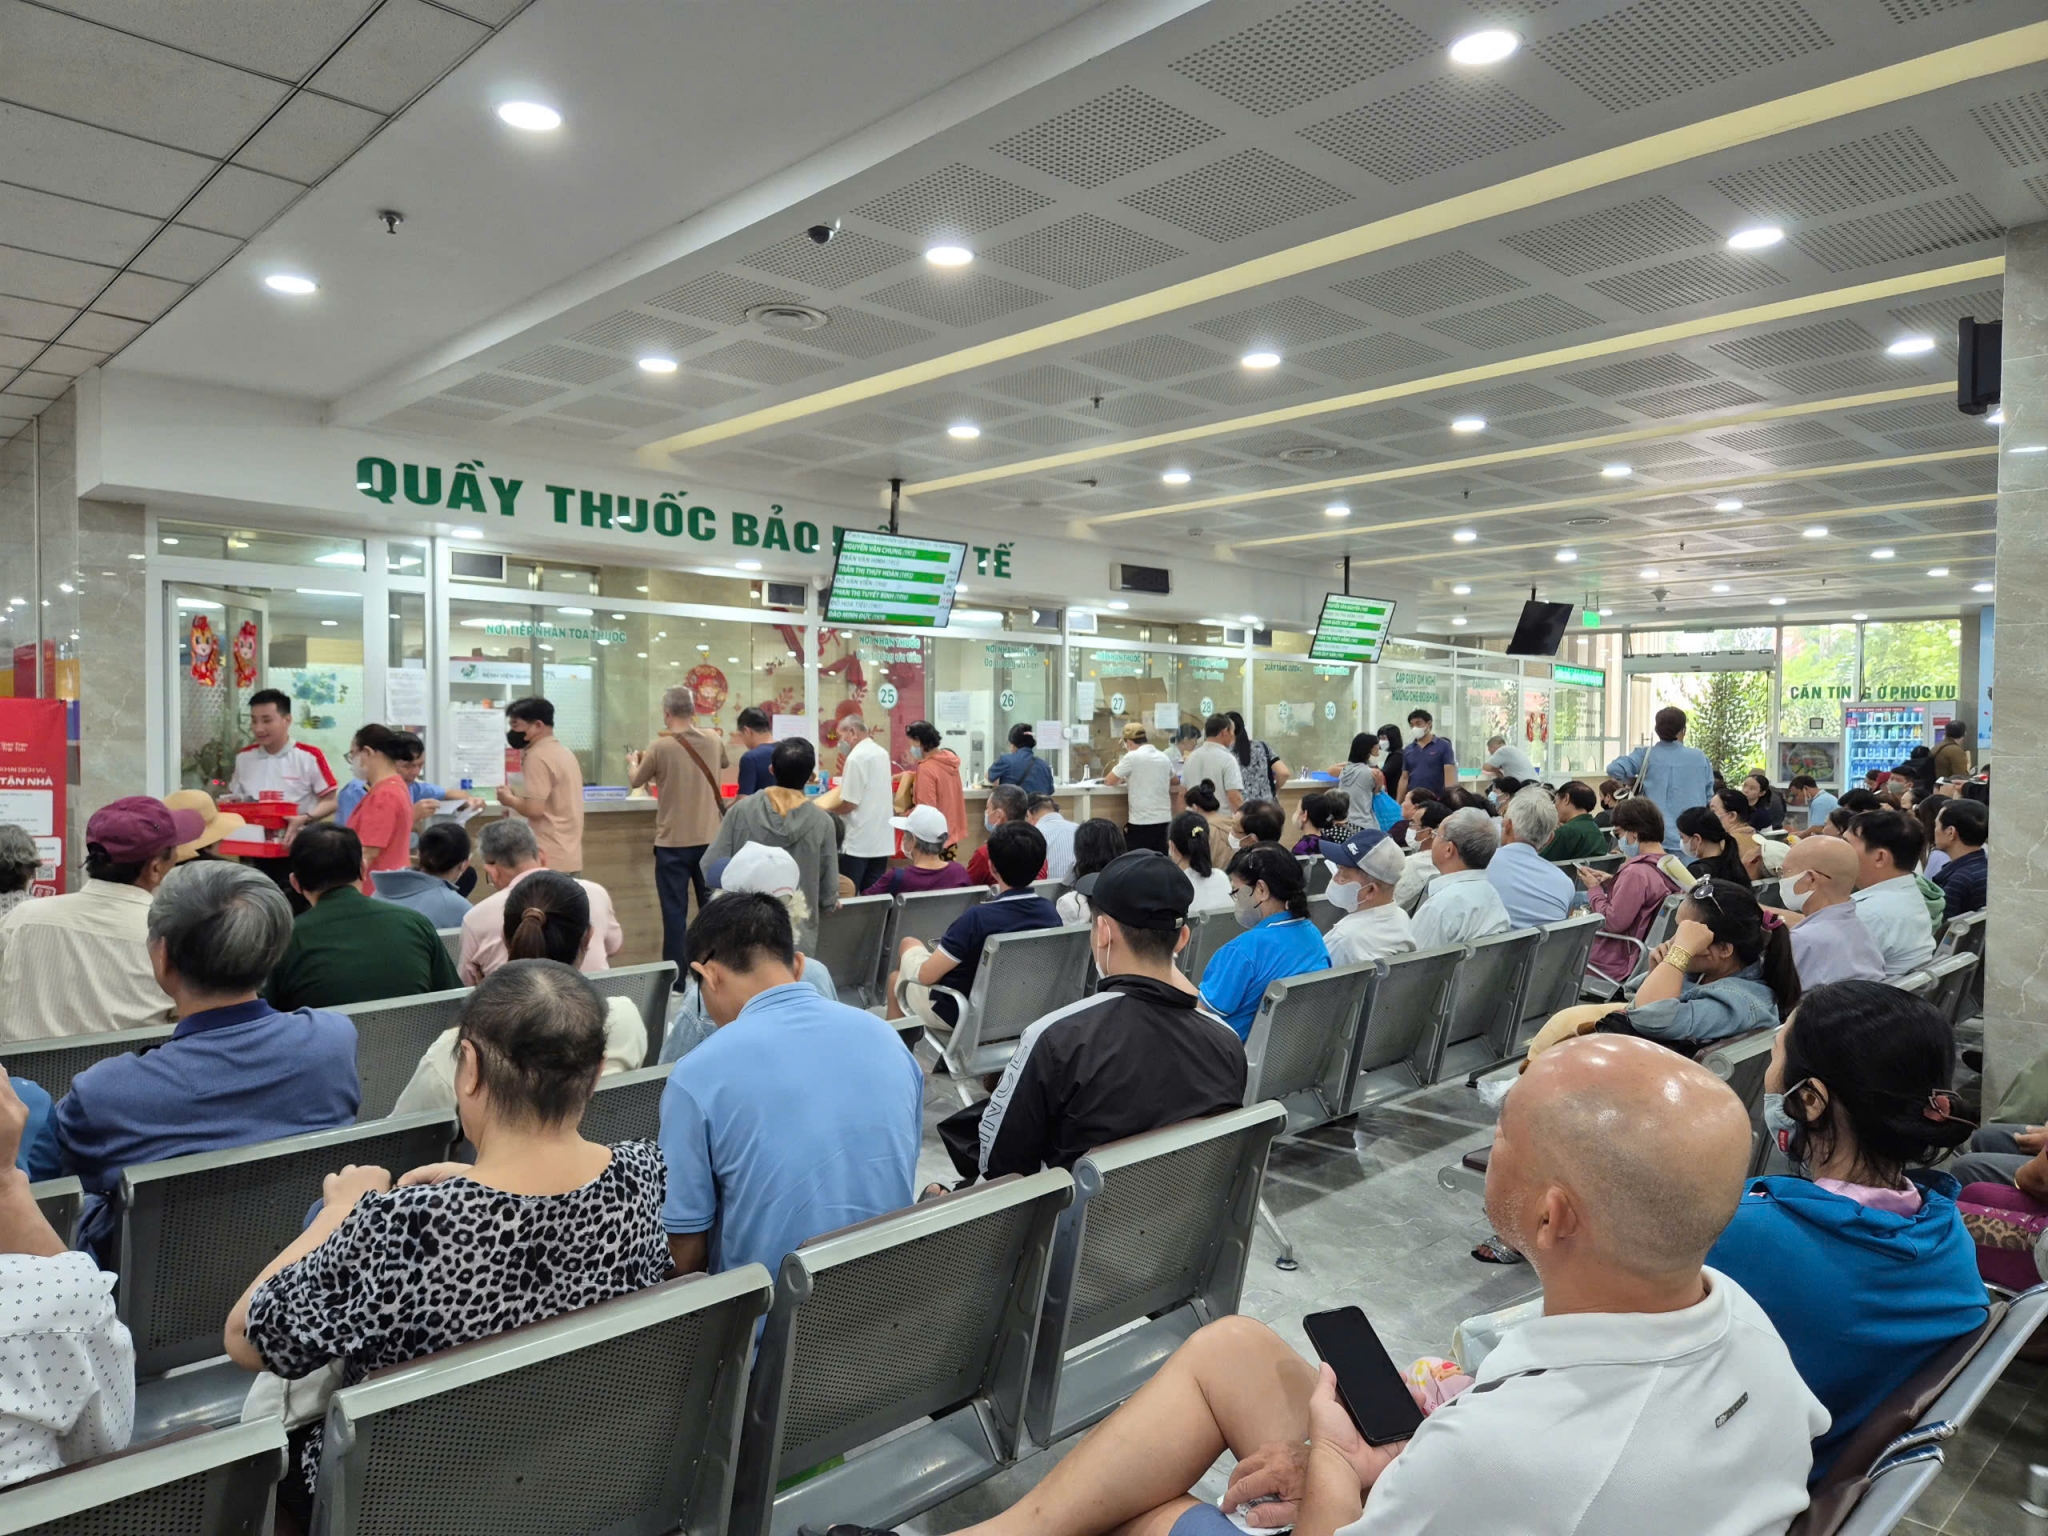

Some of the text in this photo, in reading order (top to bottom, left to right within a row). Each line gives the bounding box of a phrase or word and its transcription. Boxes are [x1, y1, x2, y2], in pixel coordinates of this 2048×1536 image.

[356, 457, 524, 517] QUẦY
[545, 484, 717, 542] THUỐC
[732, 504, 819, 554] BẢO
[972, 541, 1016, 580] TẾ
[568, 628, 590, 640] TOA
[880, 689, 895, 704] 25
[1790, 683, 1822, 700] CĂN
[1828, 685, 1852, 699] TIN
[1002, 693, 1014, 707] 26
[1113, 697, 1123, 710] 27
[1202, 701, 1211, 713] 28
[1278, 702, 1288, 715] 29
[1326, 704, 1335, 717] 30
[0, 774, 54, 787] TẬN NHÀ
